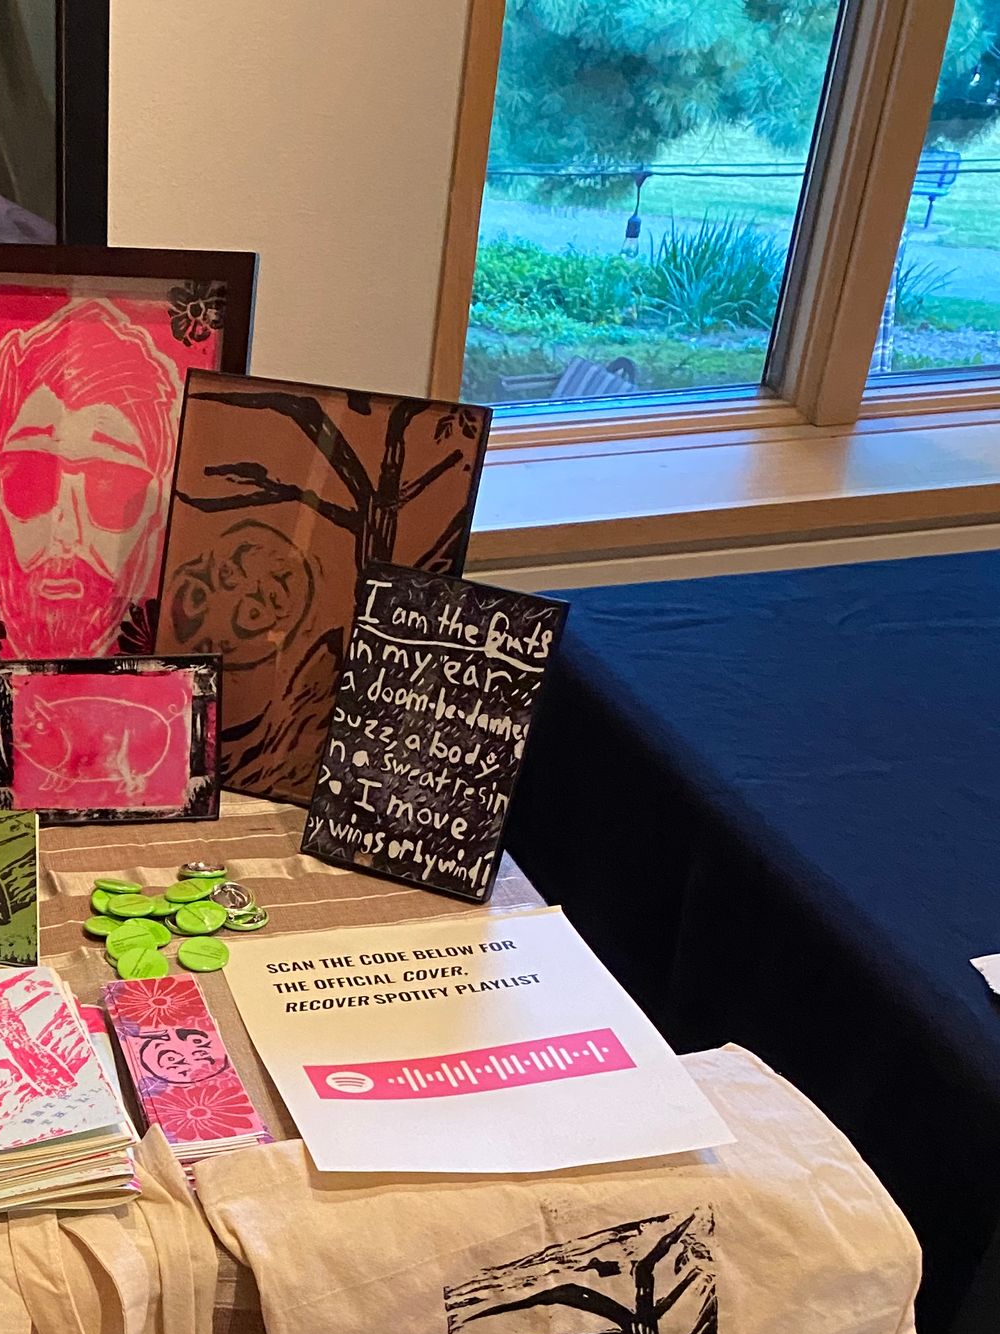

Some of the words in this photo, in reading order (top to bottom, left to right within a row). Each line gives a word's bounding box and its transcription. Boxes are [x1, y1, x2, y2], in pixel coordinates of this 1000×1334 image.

[358, 579, 392, 623] I
[392, 608, 427, 634] am
[438, 608, 479, 644] the
[350, 629, 373, 663] in
[383, 643, 432, 682] my
[444, 657, 512, 693] ear
[341, 671, 356, 692] a
[405, 734, 422, 751] a
[354, 778, 382, 812] I
[387, 795, 468, 840] move
[329, 813, 386, 854] wings
[266, 960, 316, 974] SCAN
[319, 956, 356, 969] THE
[359, 951, 410, 966] CODE
[412, 945, 474, 960] BELOW
[478, 940, 517, 953] FOR
[273, 981, 310, 994] THE
[313, 973, 396, 990] OFFICIAL
[403, 965, 469, 982] COVER.
[285, 995, 370, 1013] RECOVER
[373, 987, 450, 1005] SPOTIFY
[454, 973, 541, 995] PLAYLIST
